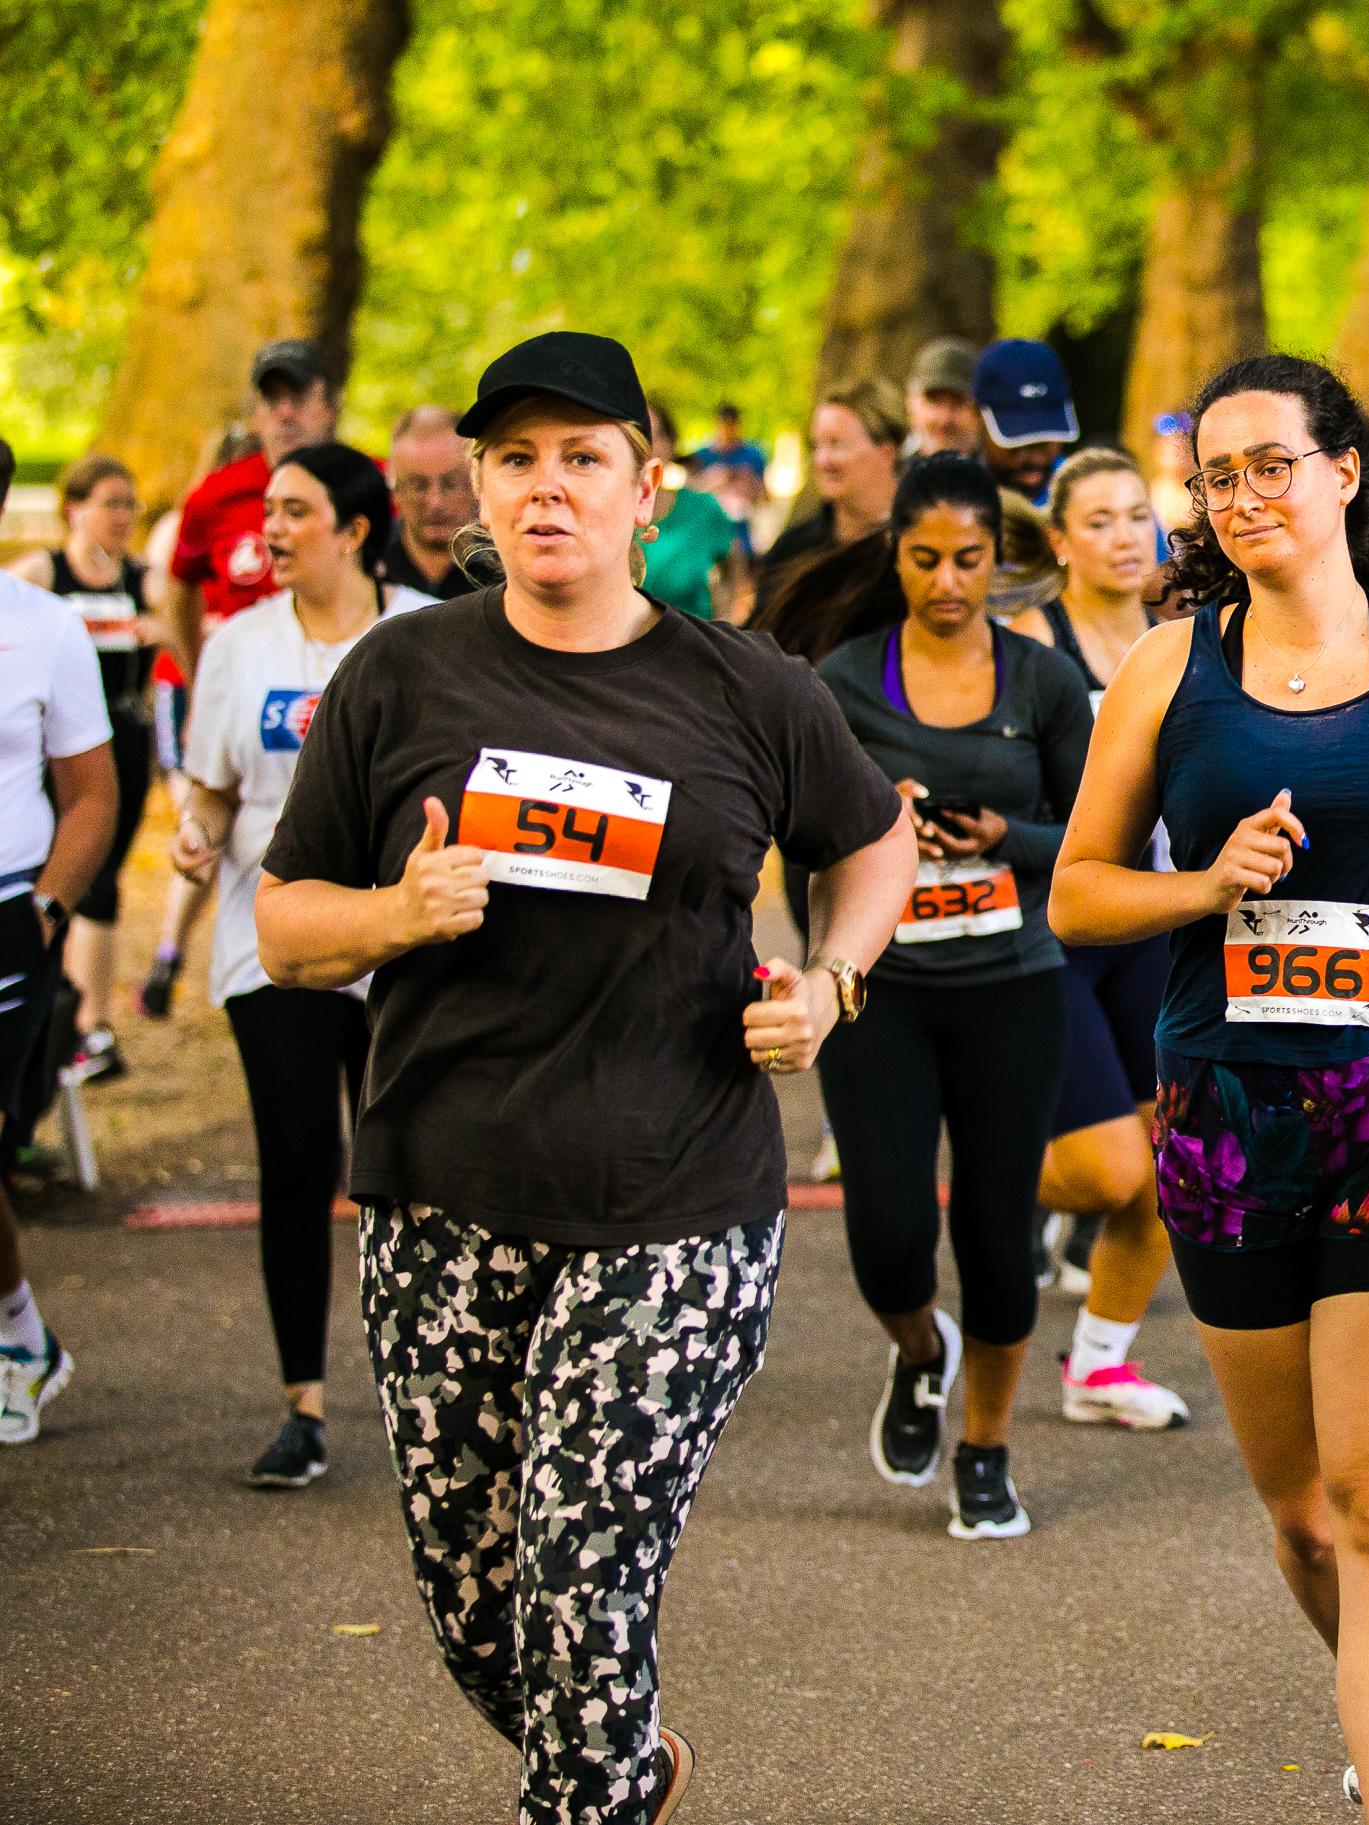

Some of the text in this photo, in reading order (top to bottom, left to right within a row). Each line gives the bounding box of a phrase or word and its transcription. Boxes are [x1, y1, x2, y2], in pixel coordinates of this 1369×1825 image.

[513, 799, 609, 863] 54
[509, 866, 600, 884] SPORTSSHOES.COM
[911, 879, 997, 920] 632
[1287, 917, 1327, 926] RunThrough
[1247, 945, 1363, 999] 966
[1261, 1006, 1343, 1017] SPORTSSHOES.COM
